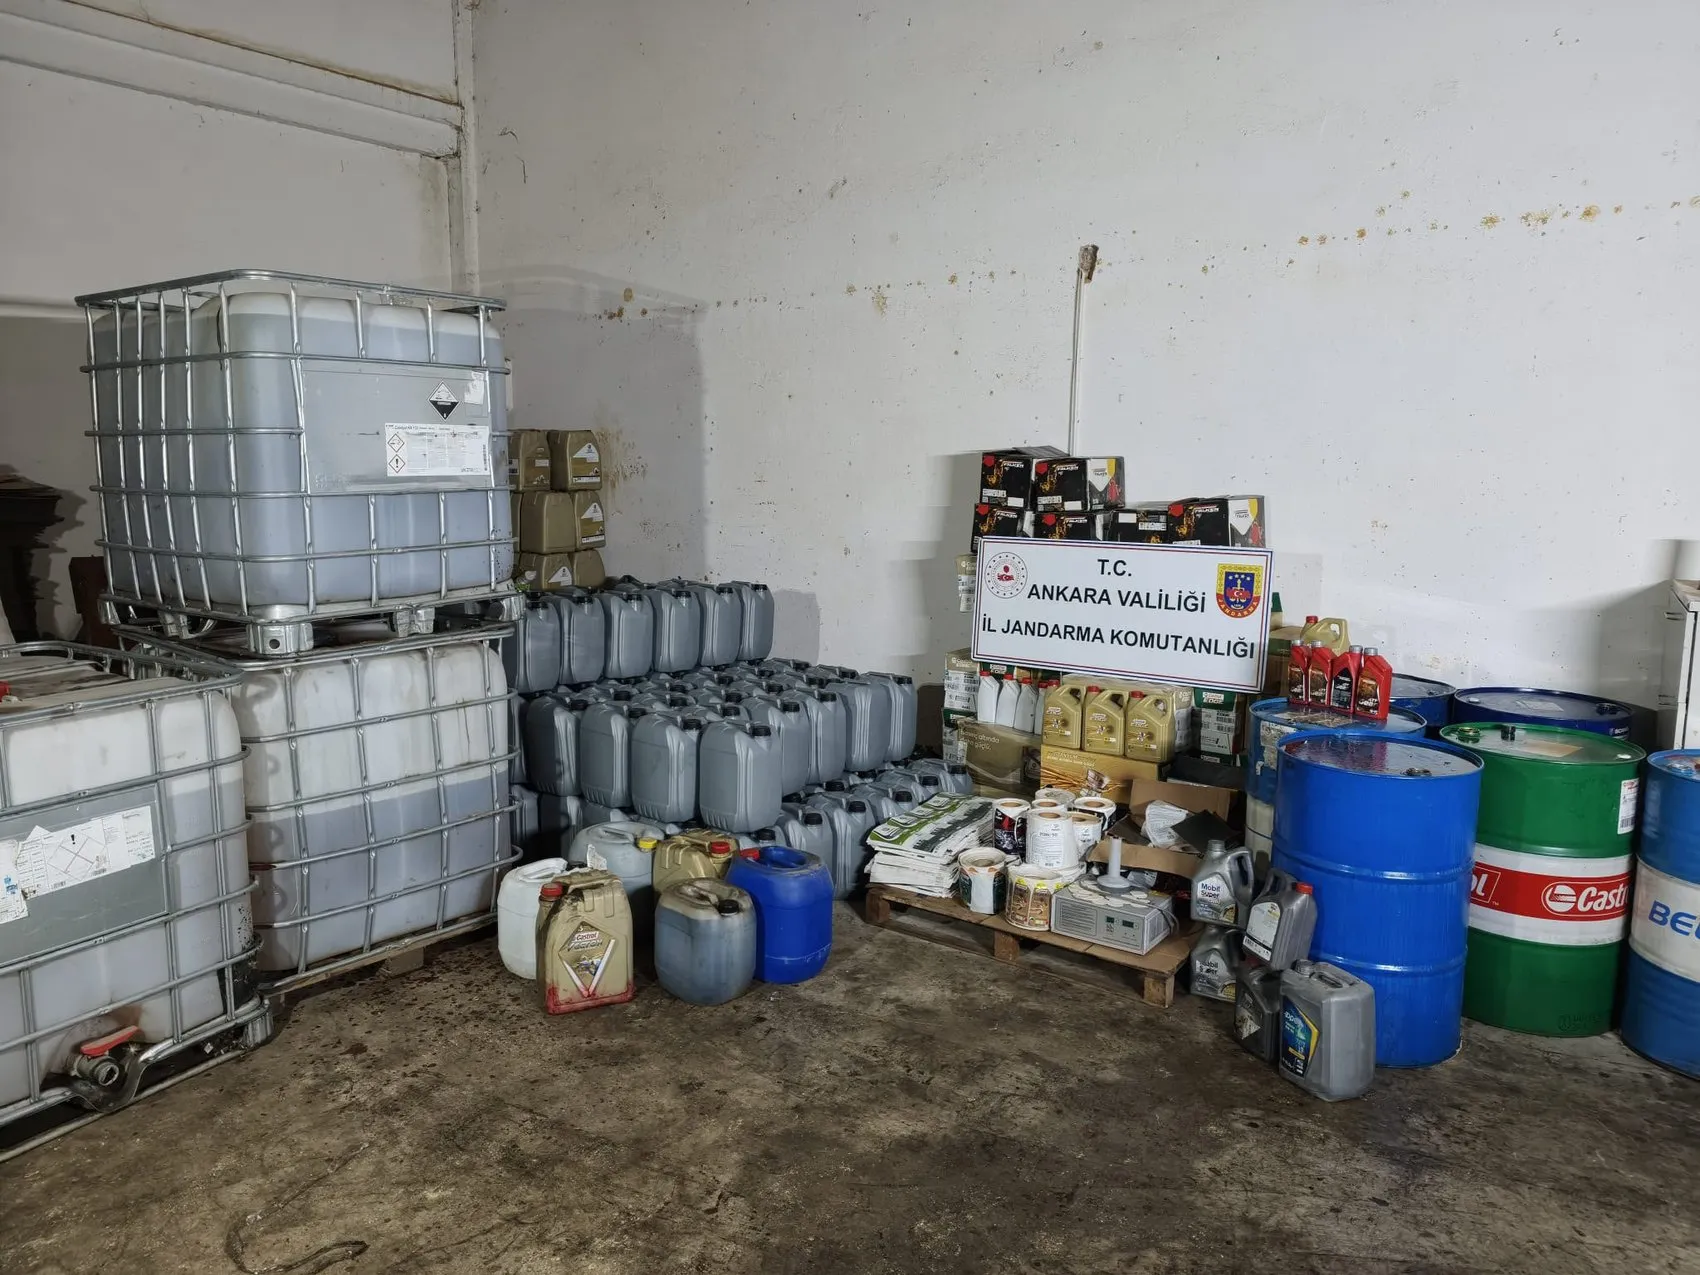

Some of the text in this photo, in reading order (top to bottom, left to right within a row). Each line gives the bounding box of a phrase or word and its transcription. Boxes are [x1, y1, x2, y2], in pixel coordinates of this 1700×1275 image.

[1097, 559, 1132, 577] T.C.
[1027, 584, 1206, 613] ANKARA VALİLİĞİ
[982, 613, 1255, 659] İL JANDARMA KOMUTANLIĞI
[1201, 883, 1221, 892] Mobil
[1648, 900, 1700, 940] BE
[576, 932, 597, 941] Castrol
